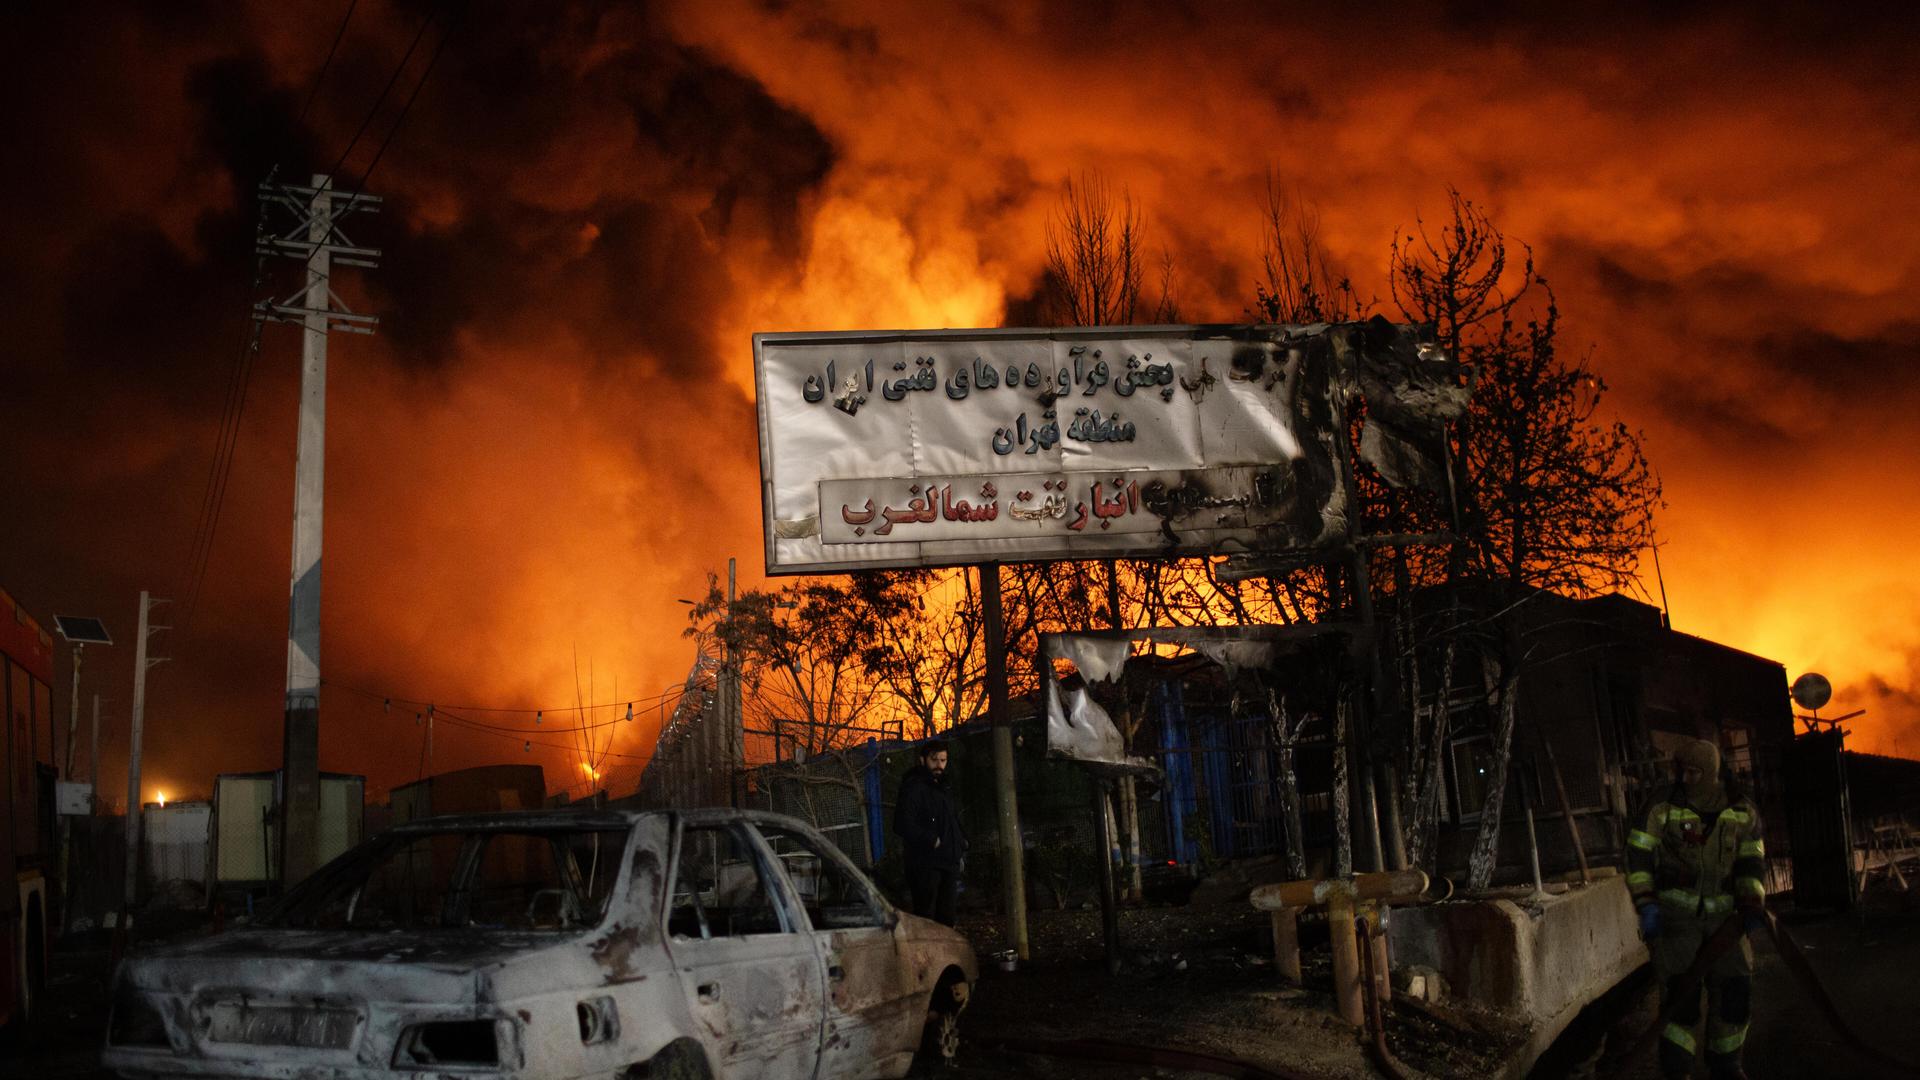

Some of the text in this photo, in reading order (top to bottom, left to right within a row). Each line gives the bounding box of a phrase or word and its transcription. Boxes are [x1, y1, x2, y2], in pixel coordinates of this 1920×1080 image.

[882, 356, 938, 401] نفتی
[1115, 352, 1174, 403] پخش
[992, 406, 1137, 456] منطقه تهران
[1008, 480, 1068, 524] نفت
[1067, 477, 1138, 531] انبار
